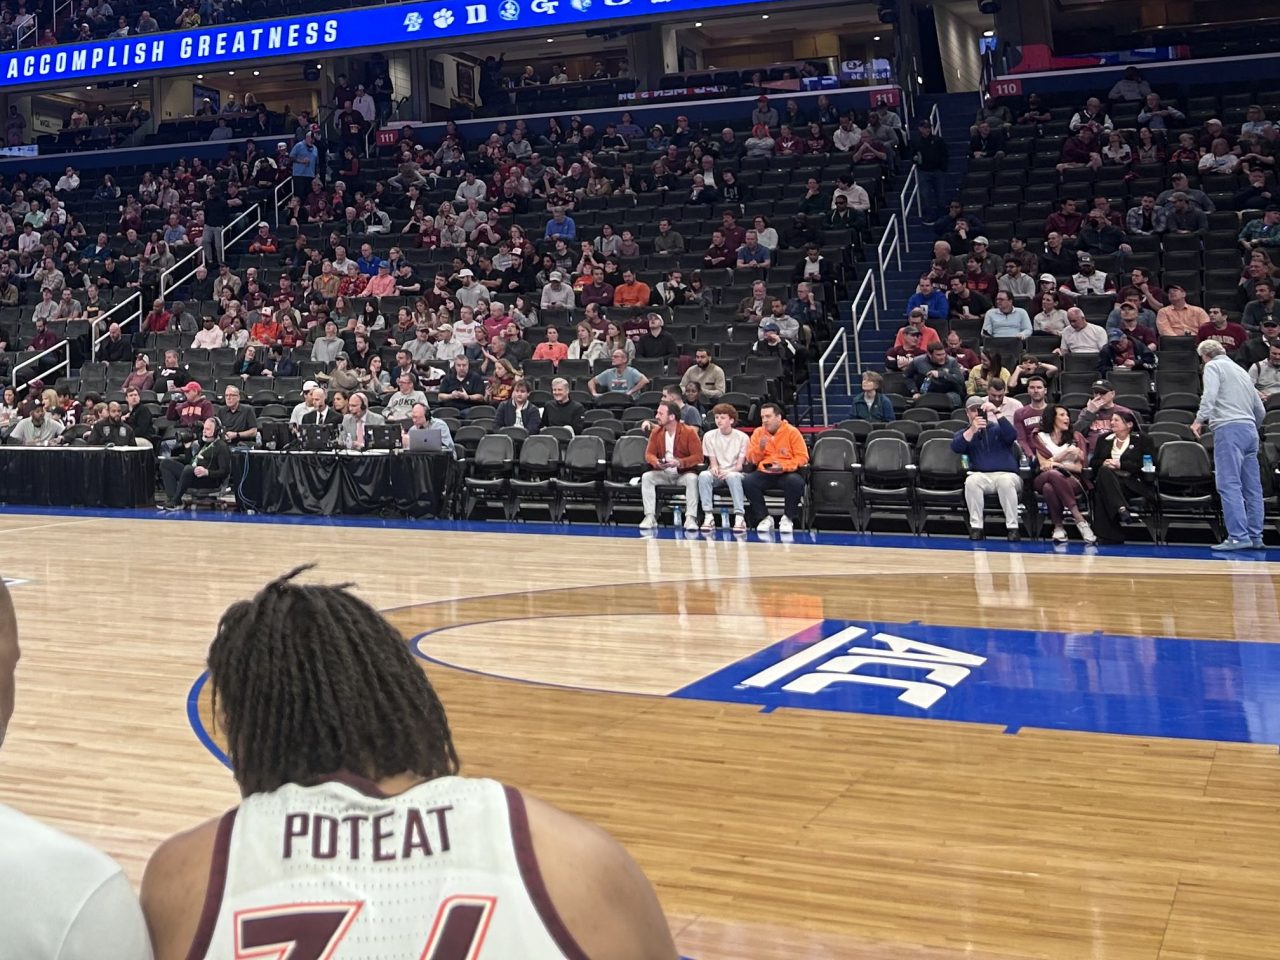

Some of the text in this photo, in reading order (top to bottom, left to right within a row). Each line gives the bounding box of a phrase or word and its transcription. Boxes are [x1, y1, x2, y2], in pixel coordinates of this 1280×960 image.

[7, 41, 164, 79] ACCOMPLISH
[180, 20, 338, 58] GREATNESS
[996, 83, 1016, 94] 110
[380, 133, 394, 143] 111
[282, 804, 455, 862] POTEAT
